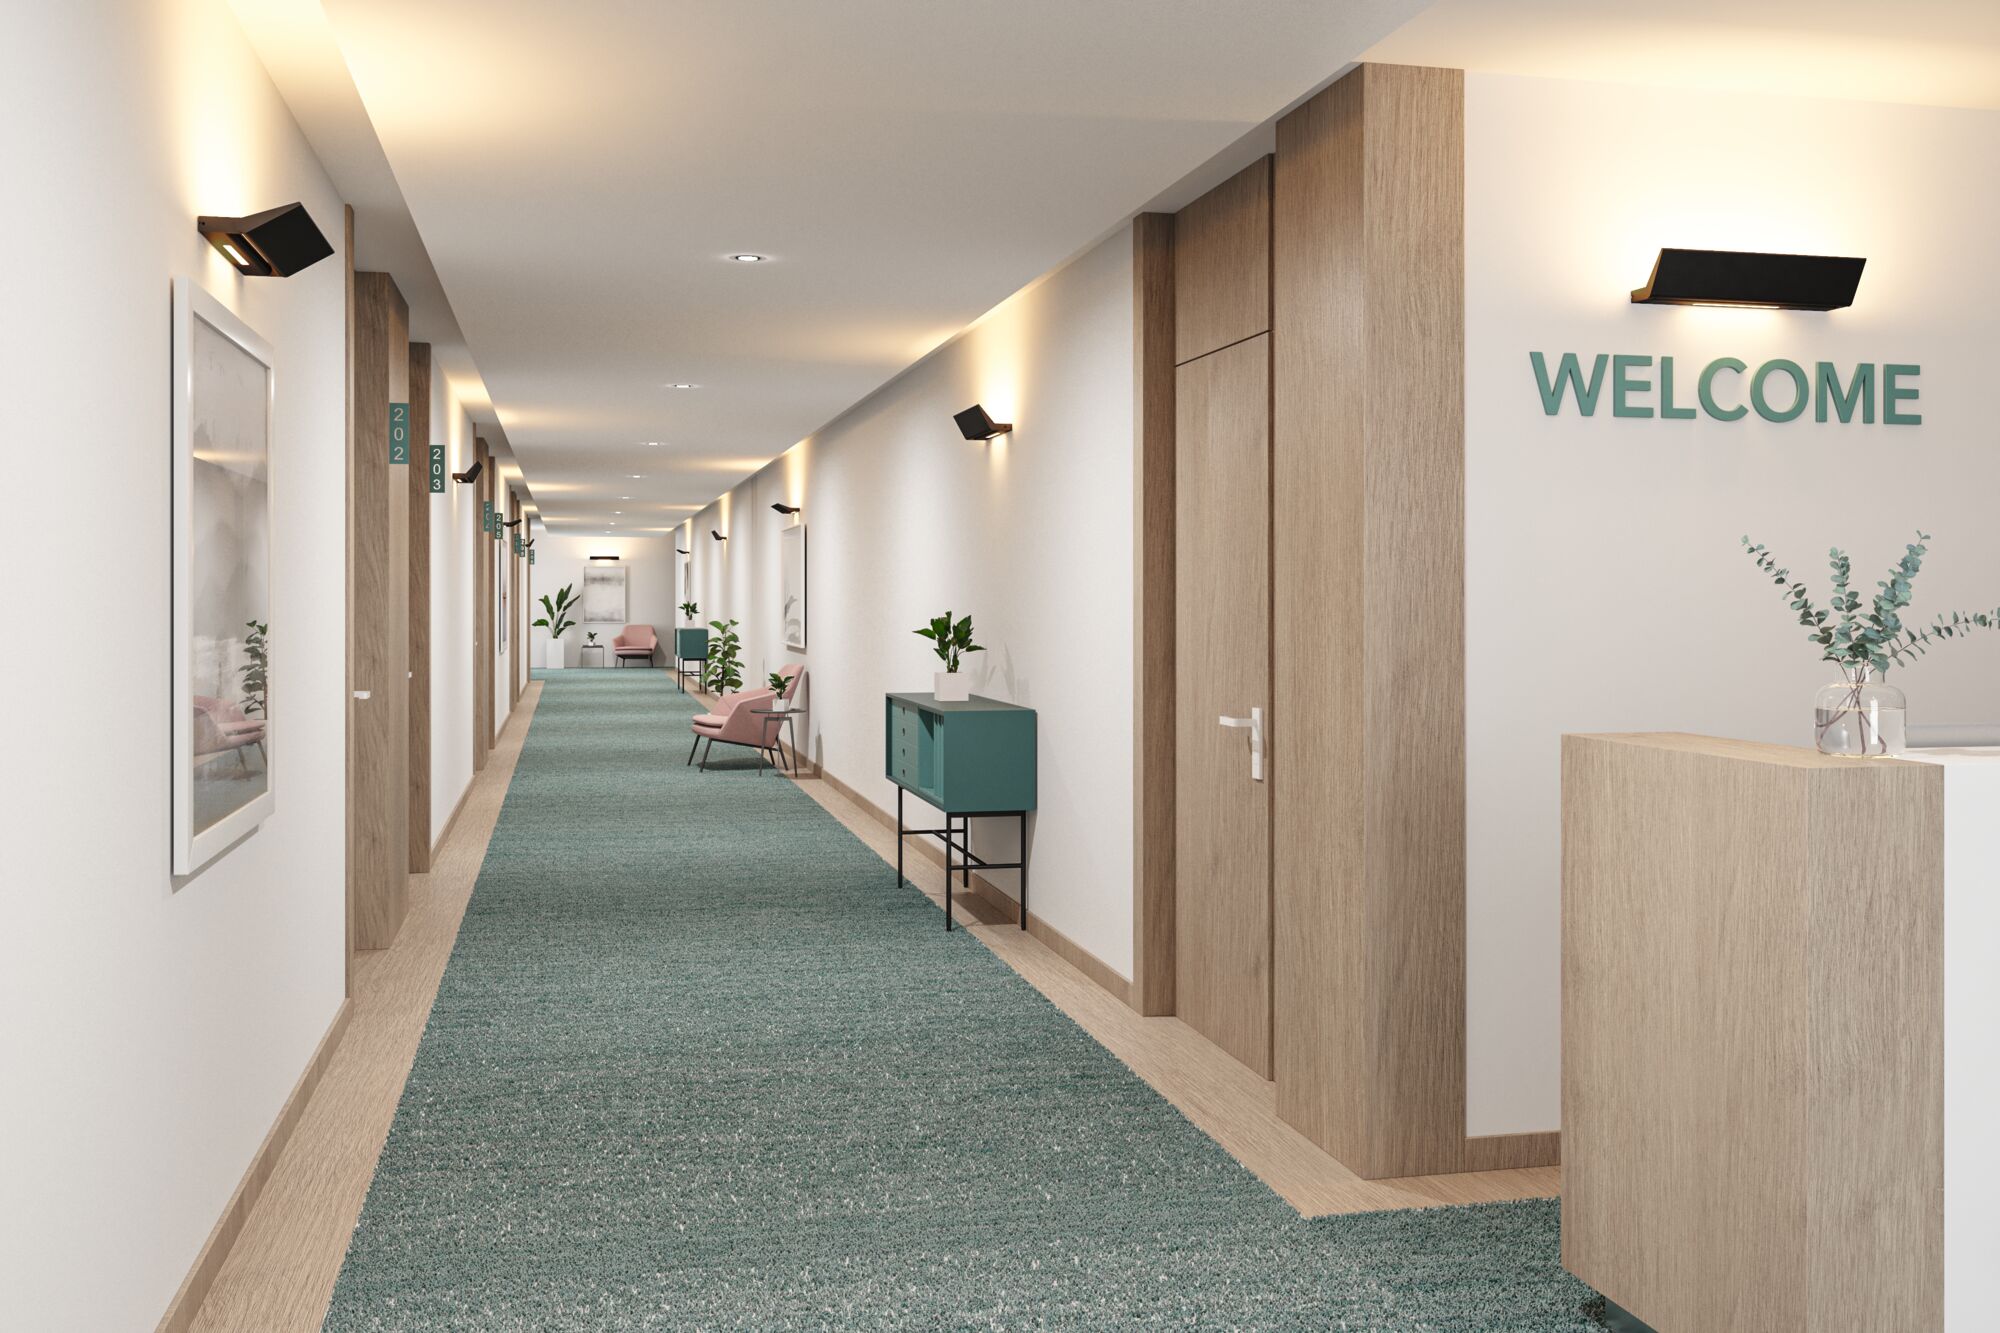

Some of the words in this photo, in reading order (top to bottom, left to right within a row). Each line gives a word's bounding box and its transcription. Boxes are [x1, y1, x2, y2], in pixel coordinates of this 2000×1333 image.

[1529, 351, 1922, 425] WELCOME
[393, 407, 404, 461] 202
[432, 448, 441, 490] 203
